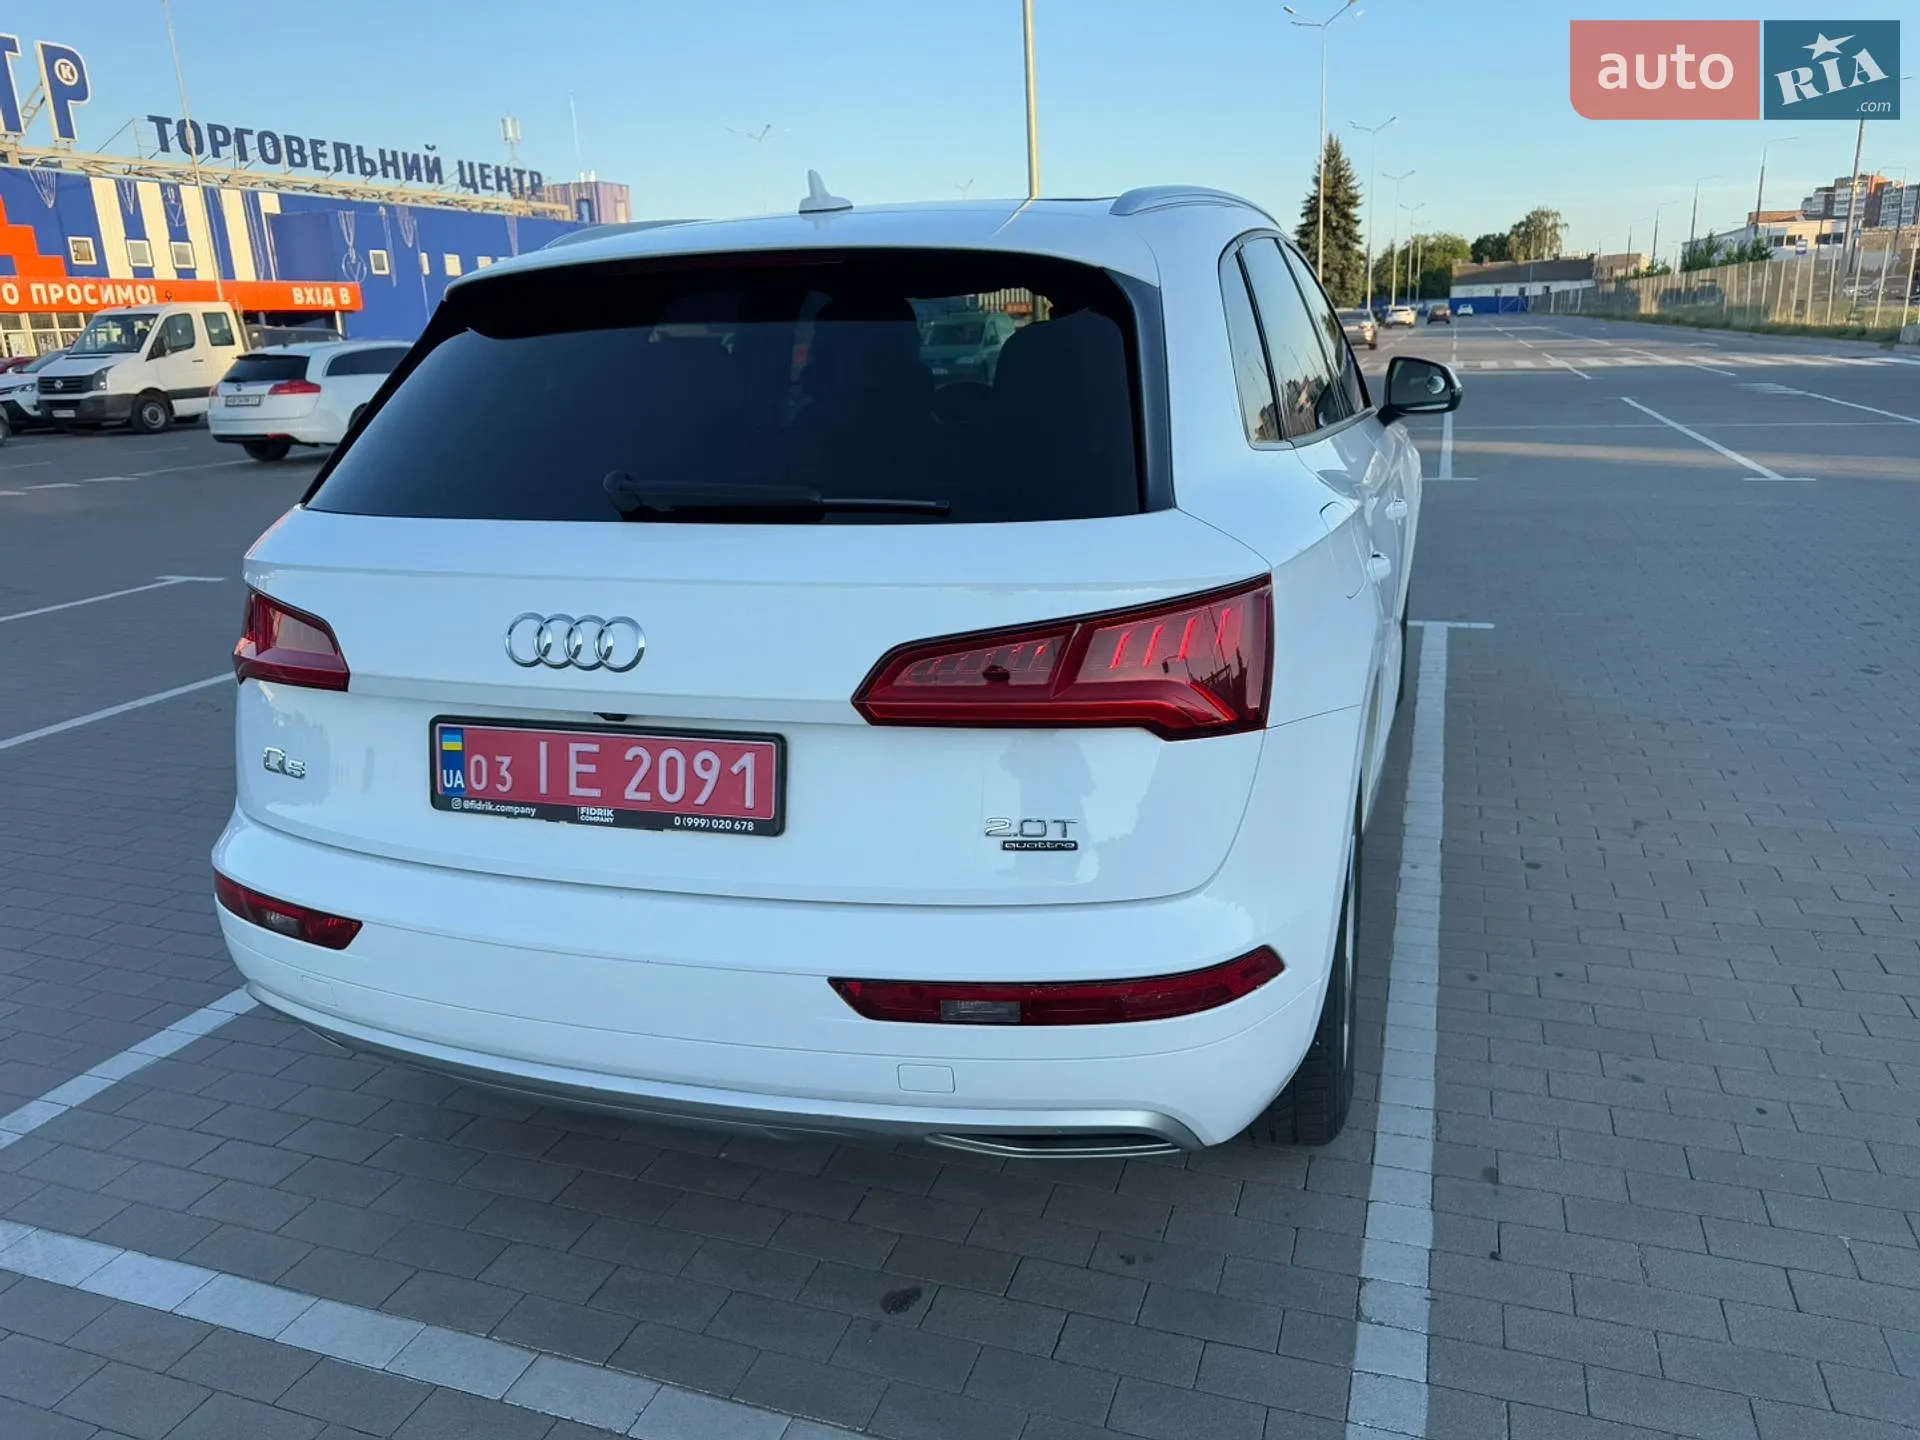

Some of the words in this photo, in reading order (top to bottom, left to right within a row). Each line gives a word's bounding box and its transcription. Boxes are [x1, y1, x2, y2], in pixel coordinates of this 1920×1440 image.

[147, 114, 444, 185] ТОРГОВЕЛЬНИЙ
[457, 159, 543, 198] ЦЕНТР
[29, 282, 159, 305] ПРОСИМО!
[292, 286, 336, 308] ВХІД
[263, 747, 306, 780] Q5
[443, 769, 464, 789] UA
[469, 754, 513, 793] 03
[538, 740, 601, 798] IE
[623, 745, 757, 810] 2091
[579, 814, 614, 824] COMPANY
[580, 806, 615, 818] FIDRIK
[674, 816, 681, 826] 0
[682, 817, 710, 829] (999)
[711, 819, 732, 830] 020
[734, 821, 754, 832] 678
[985, 817, 1079, 839] 2.0T
[1004, 841, 1075, 850] quattro
